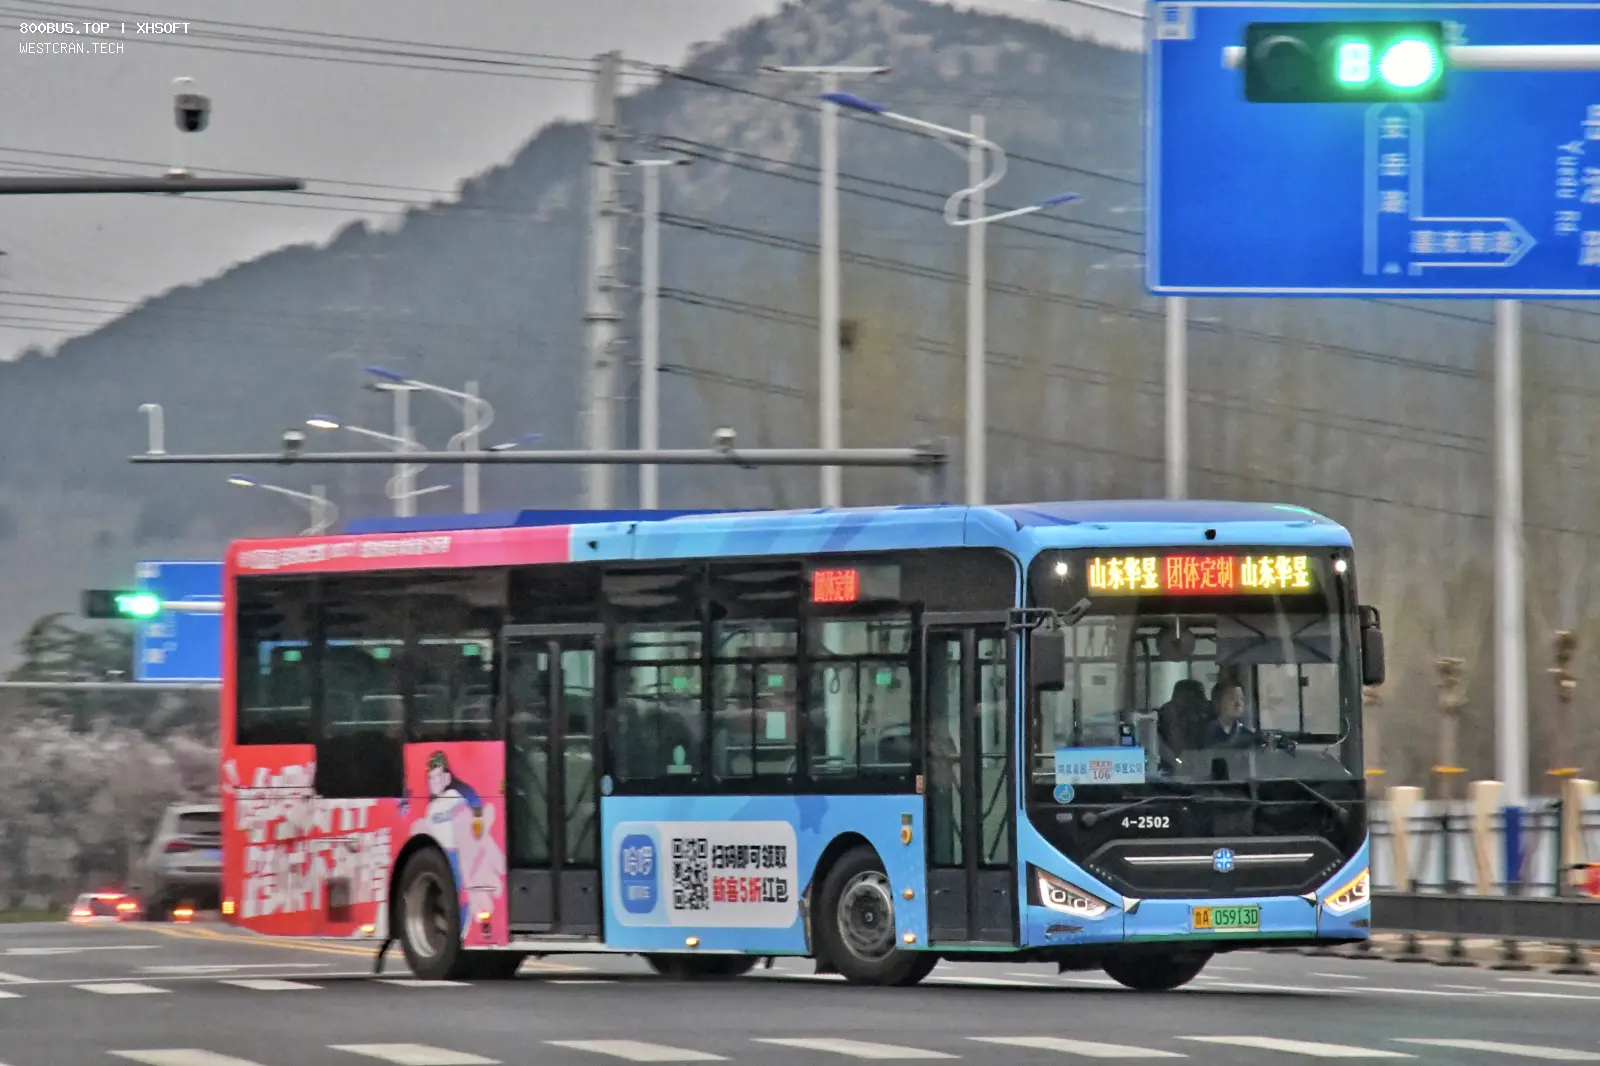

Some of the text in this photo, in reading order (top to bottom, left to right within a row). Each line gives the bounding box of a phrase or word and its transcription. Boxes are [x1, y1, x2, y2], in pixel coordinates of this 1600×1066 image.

[1089, 556, 1310, 589] 山东华昱 团体定制 山东华昱
[1092, 770, 1111, 780] 106
[1121, 816, 1170, 829] 4-2502
